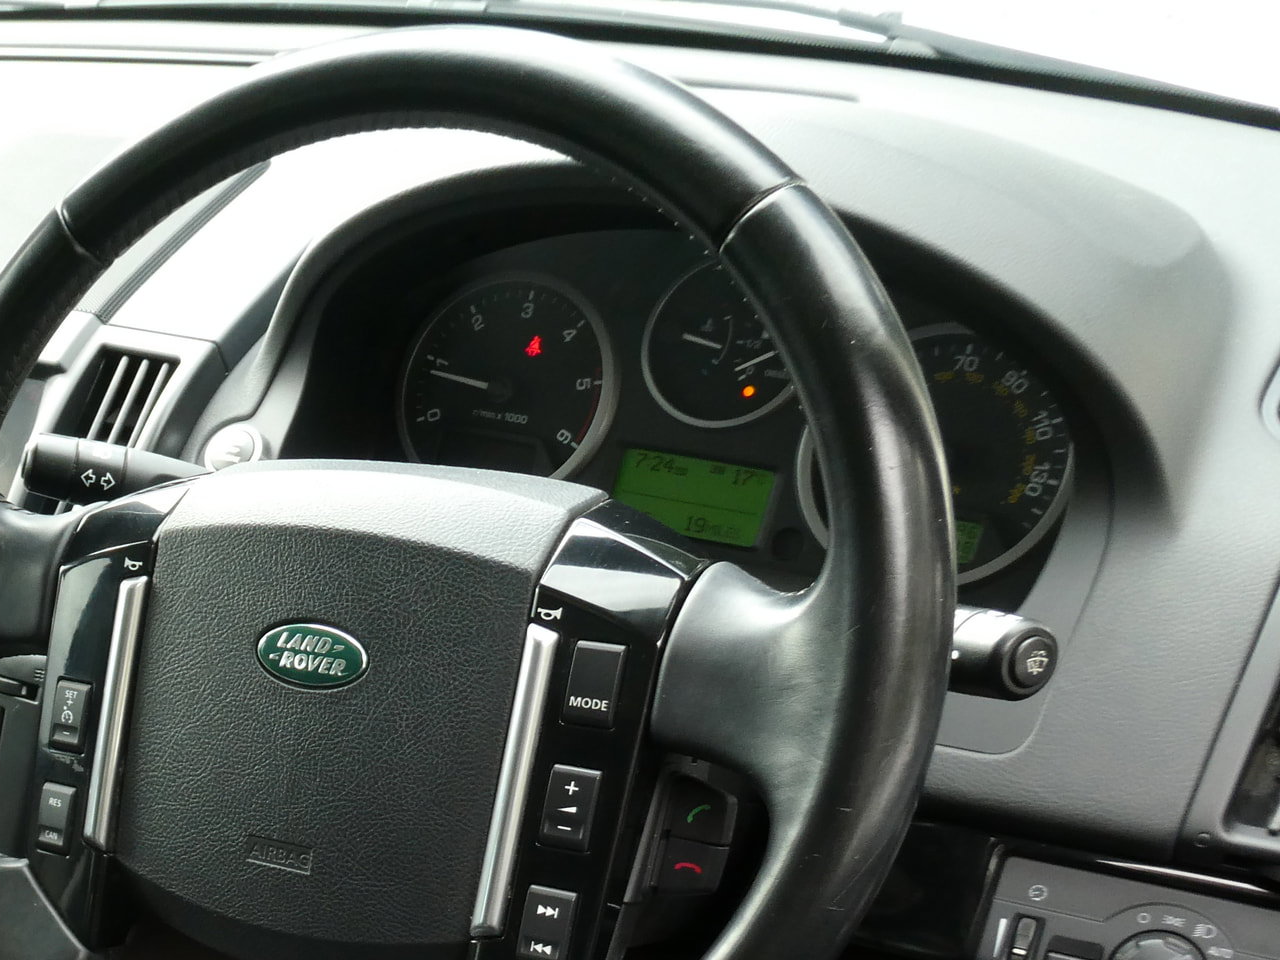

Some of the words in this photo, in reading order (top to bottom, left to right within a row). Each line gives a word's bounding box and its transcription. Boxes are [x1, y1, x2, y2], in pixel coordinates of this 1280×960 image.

[521, 303, 534, 318] 3
[471, 314, 485, 331] 2
[562, 329, 577, 343] 4
[954, 356, 980, 372] 70
[575, 377, 591, 391] 5
[427, 408, 441, 422] 0
[504, 412, 529, 425] 1000
[1030, 411, 1053, 441] 110
[556, 429, 571, 444] 6
[277, 632, 332, 653] LAND
[279, 651, 349, 676] ROVER
[64, 689, 78, 699] SET
[569, 696, 609, 711] MODE
[48, 797, 62, 808] RES
[250, 845, 311, 869] AIRBAG
